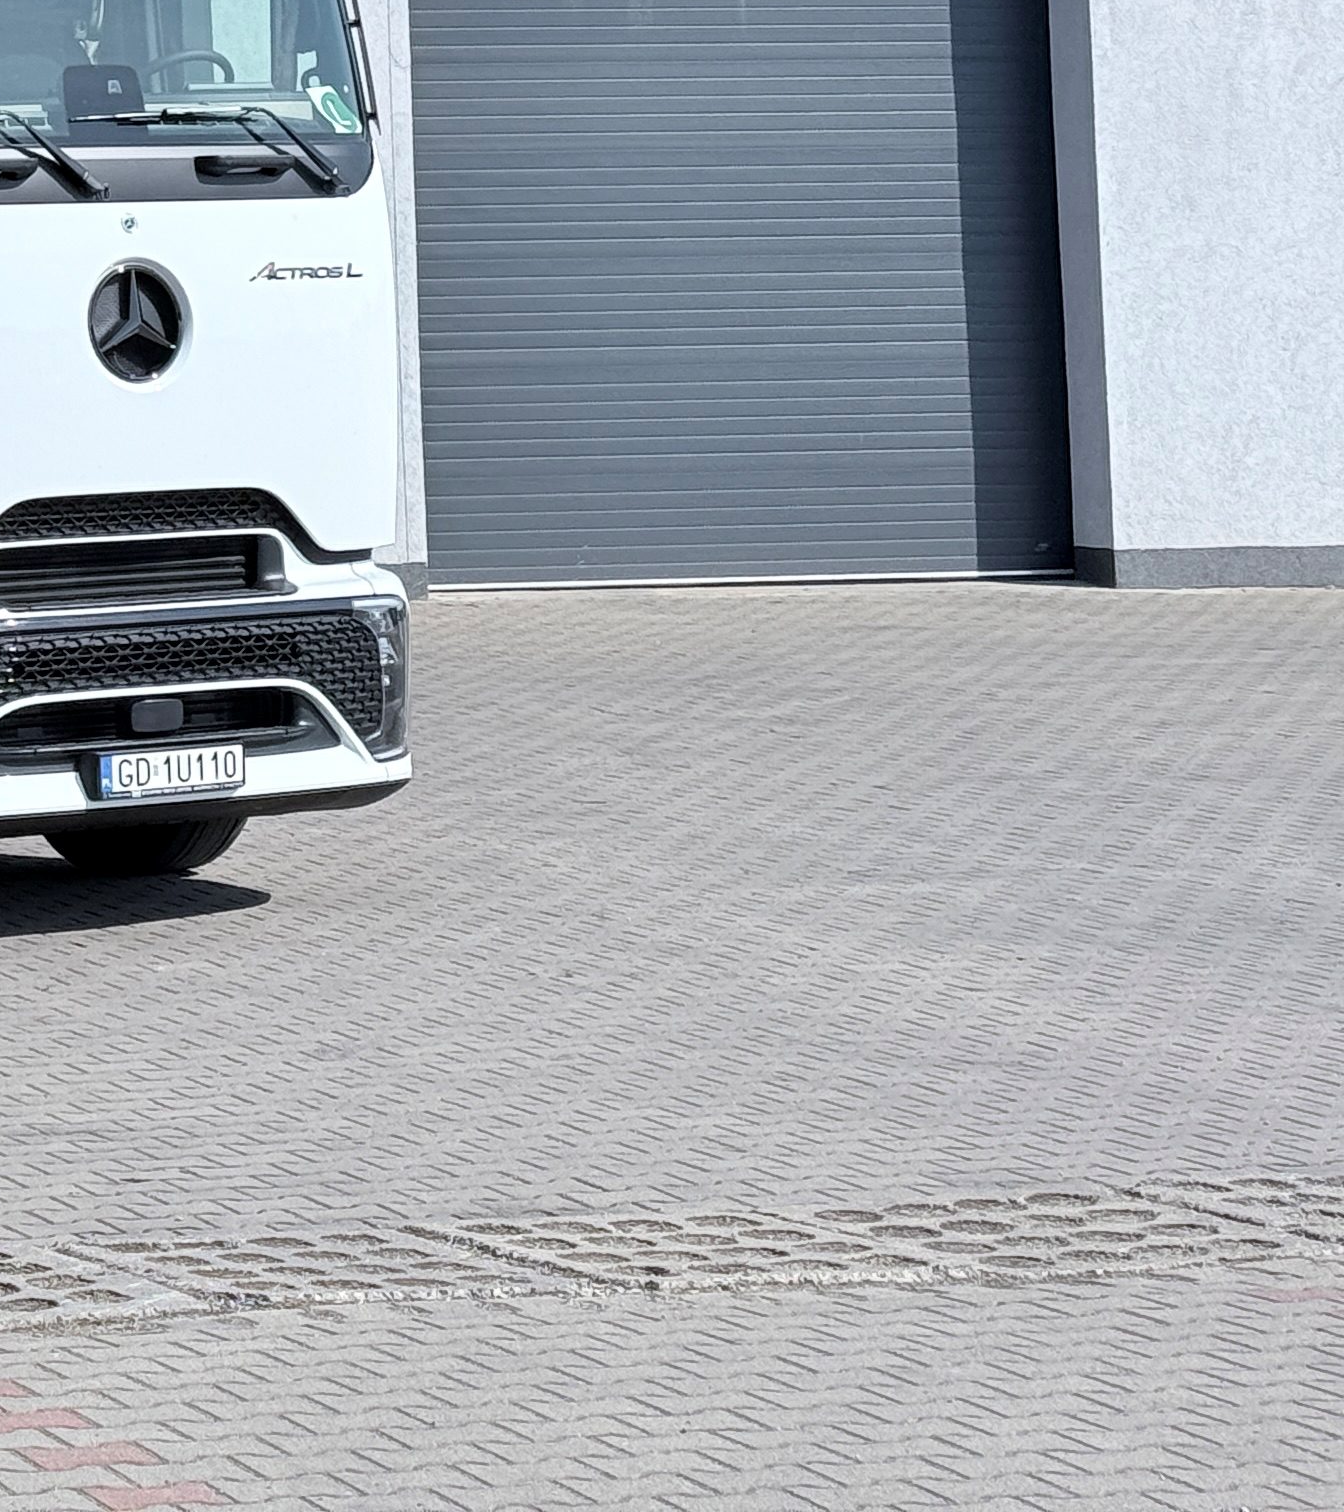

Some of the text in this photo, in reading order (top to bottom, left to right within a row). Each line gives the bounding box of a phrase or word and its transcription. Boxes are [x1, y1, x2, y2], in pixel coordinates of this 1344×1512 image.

[346, 262, 363, 278] L
[118, 750, 236, 788] GD 1U110
